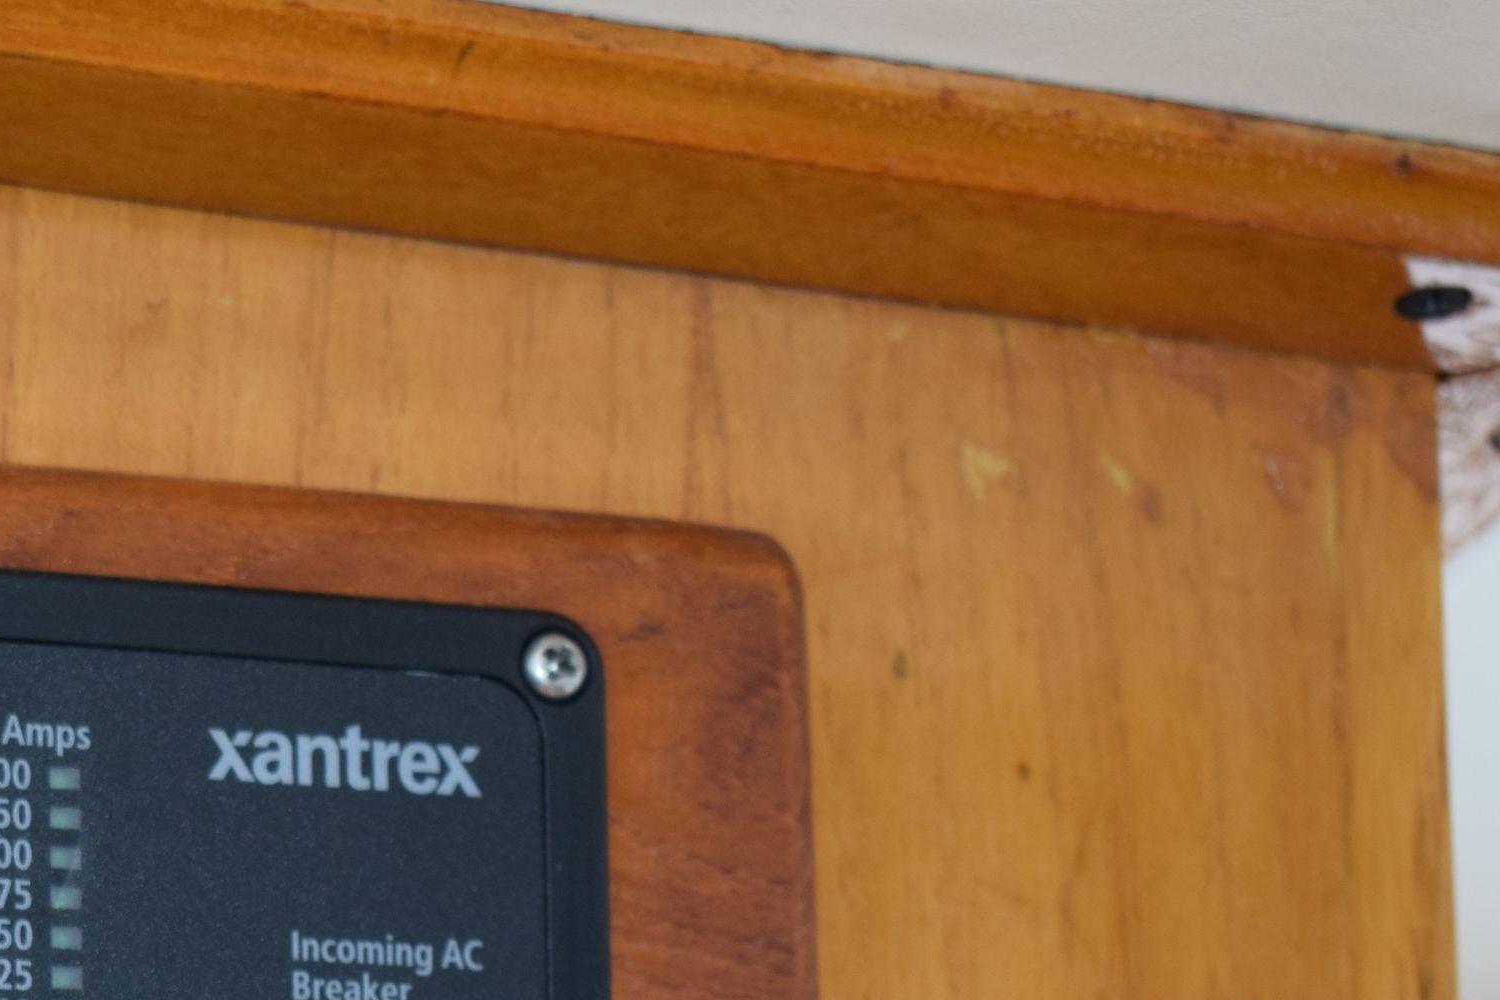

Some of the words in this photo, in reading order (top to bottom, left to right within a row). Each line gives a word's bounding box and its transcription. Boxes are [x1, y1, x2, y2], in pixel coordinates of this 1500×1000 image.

[2, 714, 90, 756] Amps
[209, 725, 480, 796] xantrex
[291, 931, 433, 976] Incoming
[441, 939, 482, 971] AC
